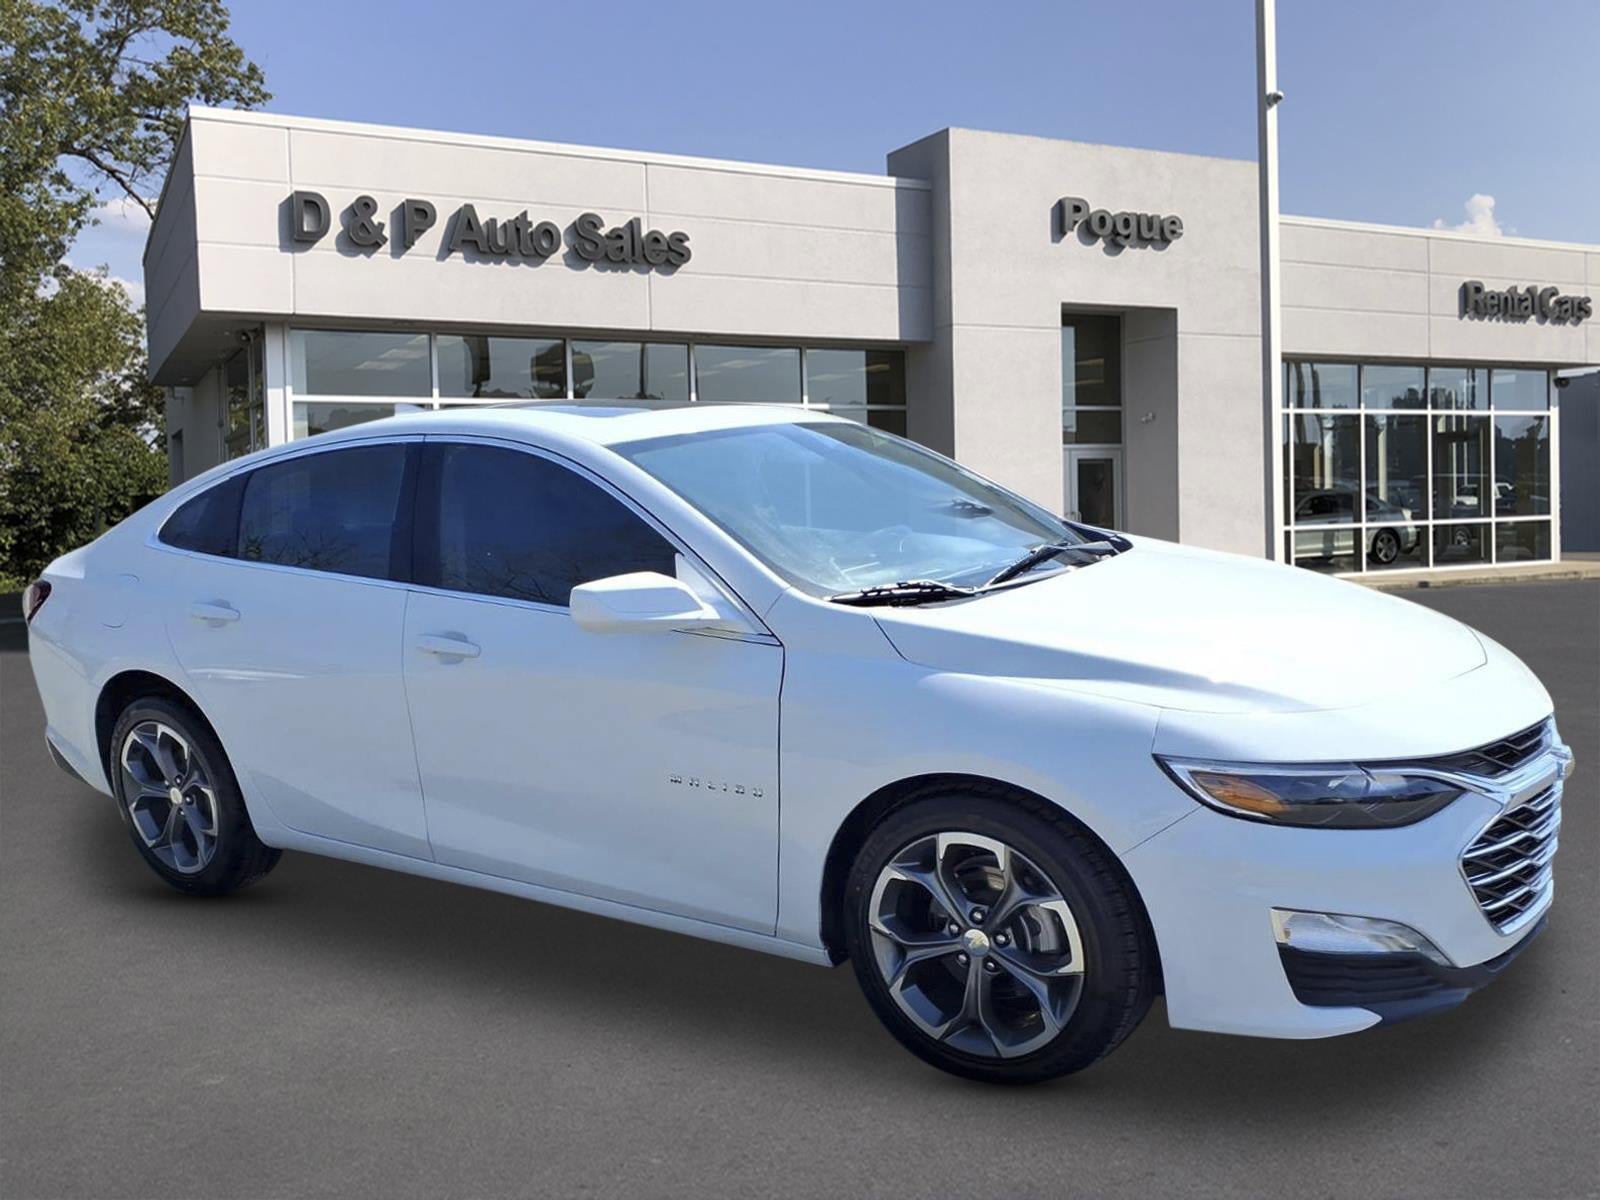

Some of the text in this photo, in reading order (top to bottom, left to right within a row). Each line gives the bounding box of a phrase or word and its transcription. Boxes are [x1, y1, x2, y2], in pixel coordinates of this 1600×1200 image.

[286, 190, 692, 272] D & P Auto Sales
[1055, 196, 1184, 253] Pogue
[1461, 280, 1593, 324] Rental Cars
